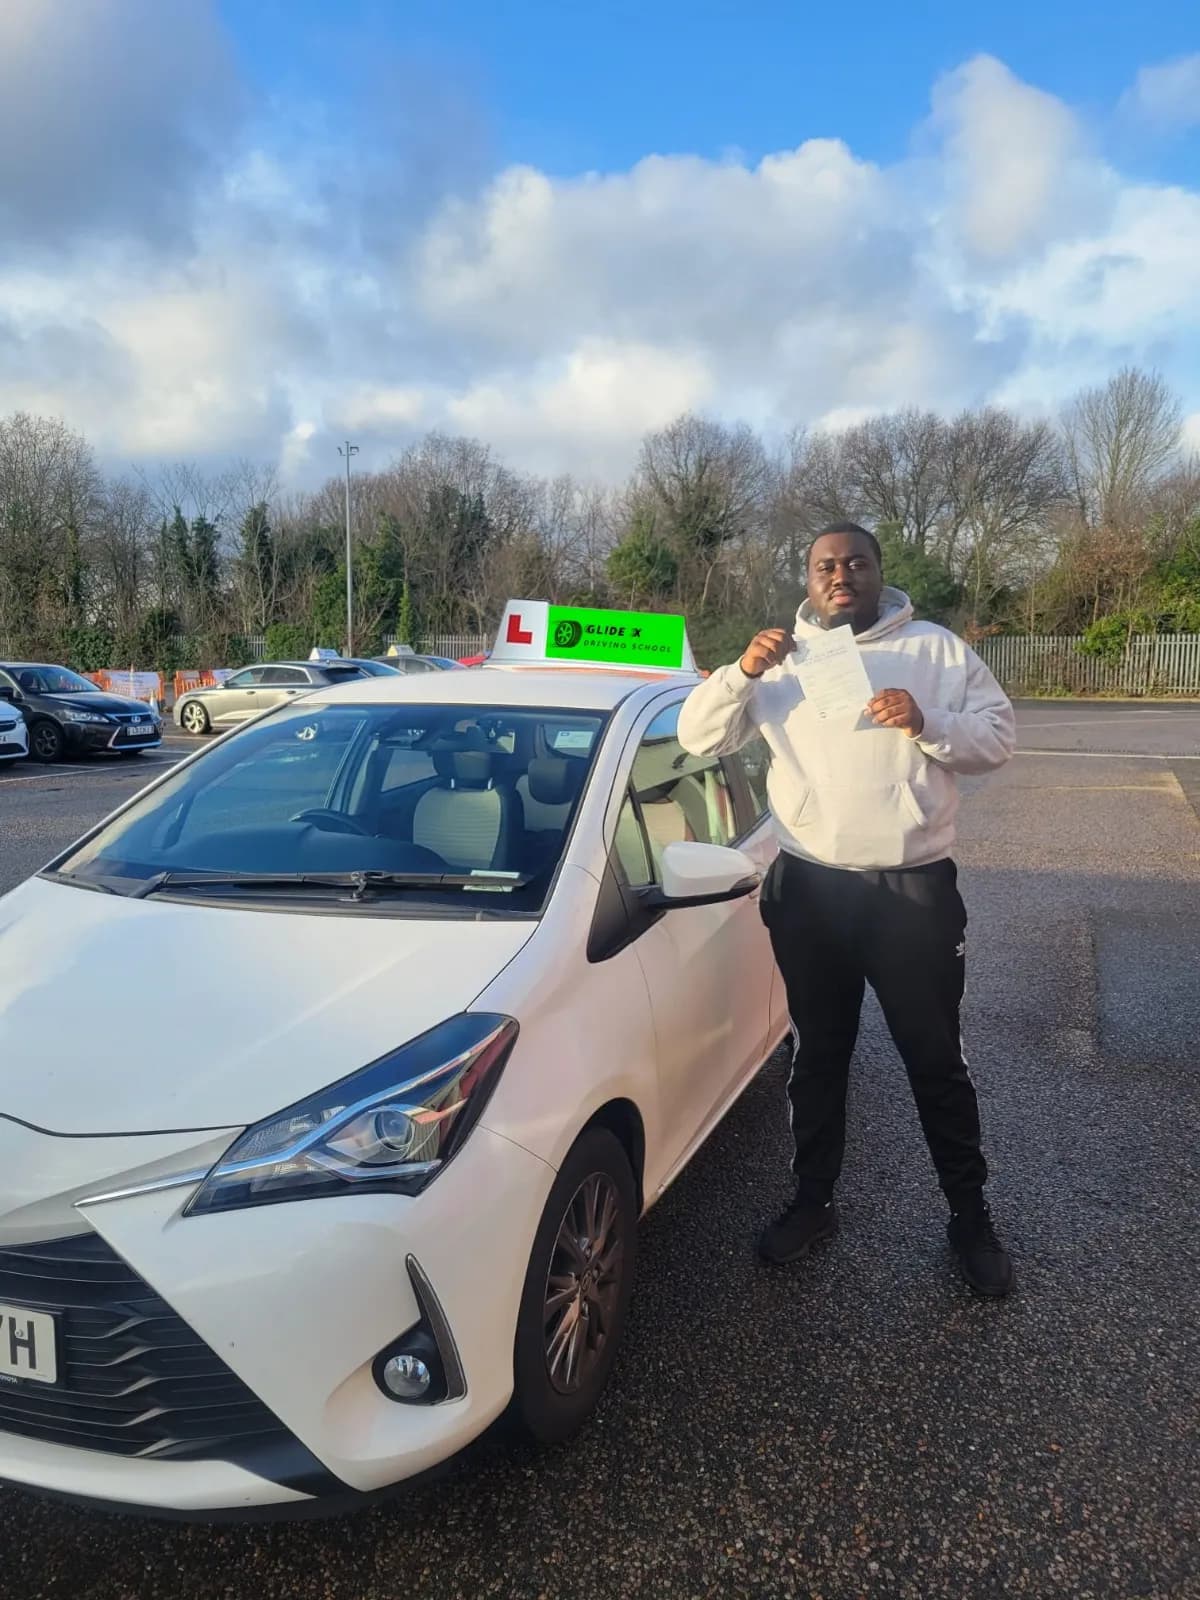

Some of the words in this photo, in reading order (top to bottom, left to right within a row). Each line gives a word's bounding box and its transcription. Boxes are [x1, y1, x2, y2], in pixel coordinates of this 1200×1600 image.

[507, 614, 532, 644] L
[585, 624, 626, 637] GLIDE
[631, 627, 642, 638] X
[583, 639, 627, 649] DRIVING
[631, 642, 672, 653] SCHOOL
[0, 1314, 36, 1370] H
